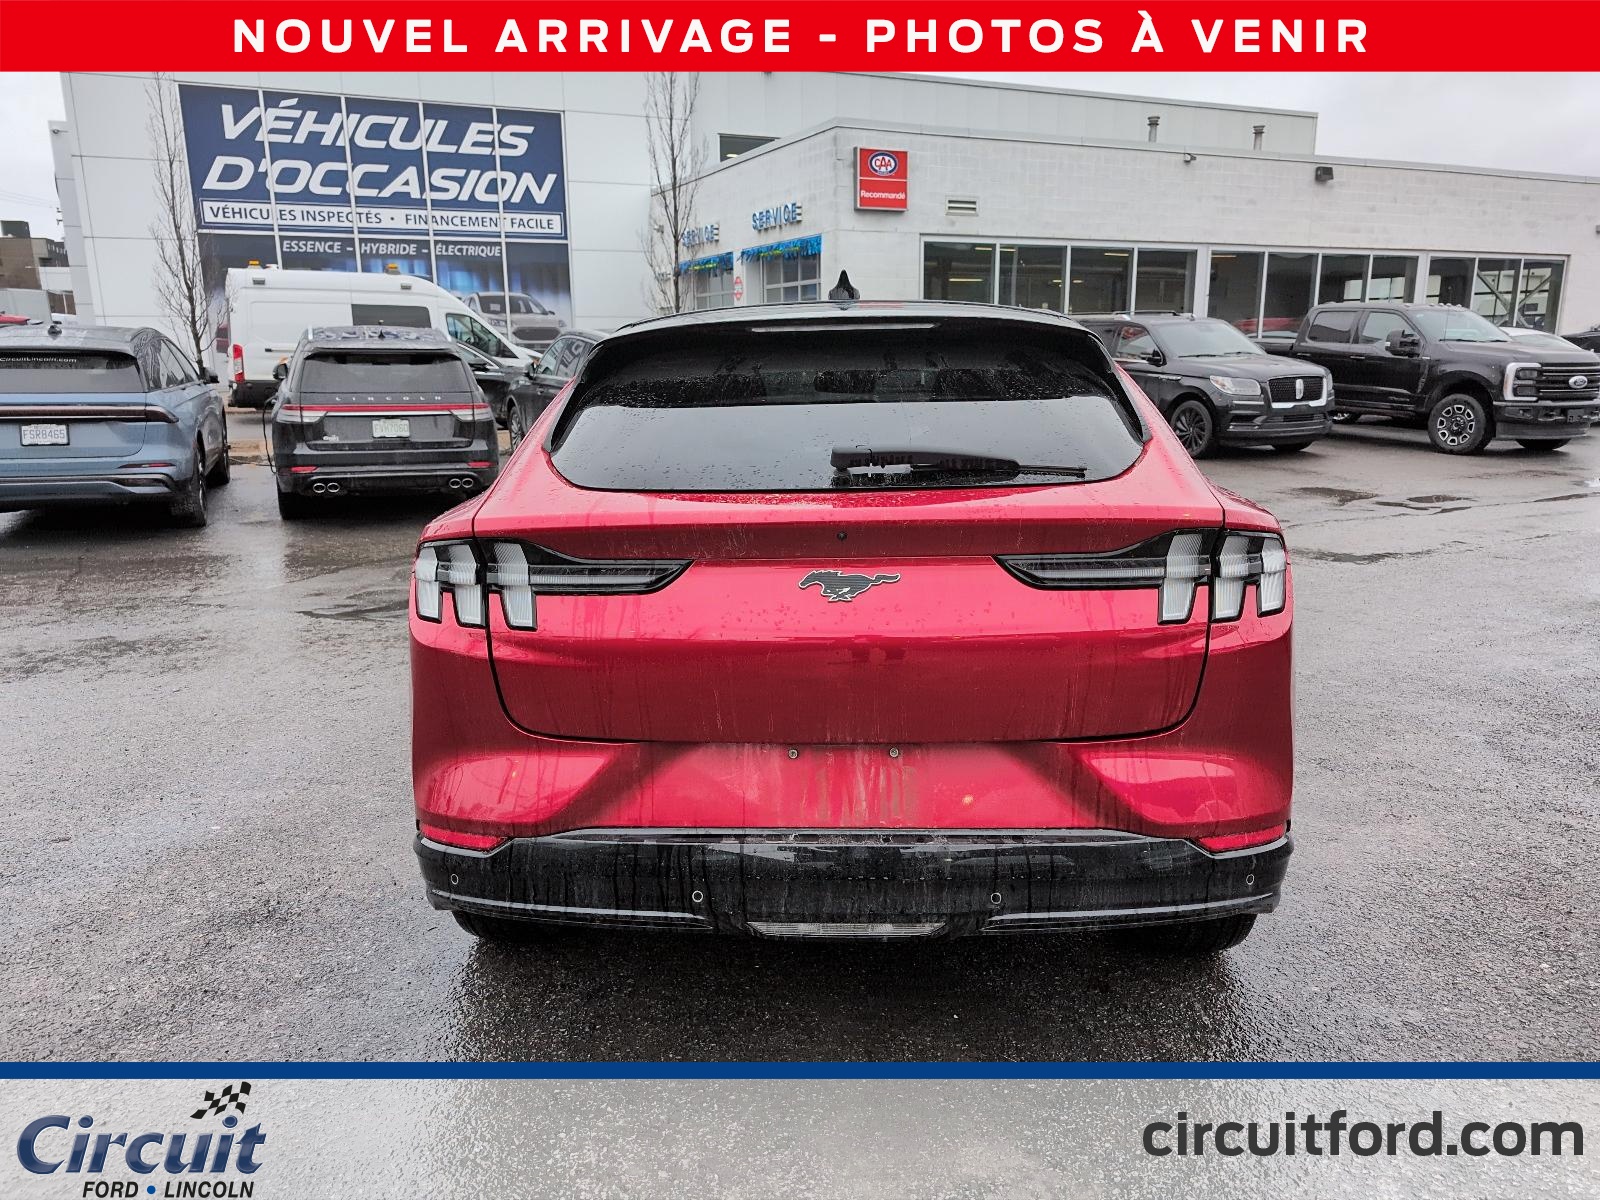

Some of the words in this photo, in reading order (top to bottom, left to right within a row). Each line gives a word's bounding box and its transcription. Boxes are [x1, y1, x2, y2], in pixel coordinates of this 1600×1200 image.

[221, 97, 535, 157] VÉHICULES
[875, 156, 892, 170] CAA
[202, 155, 558, 205] D'OCCASION
[860, 190, 906, 200] Recommandé
[209, 204, 297, 221] VÉHICUES
[301, 209, 383, 224] INSPECTÉS
[511, 218, 554, 230] FACILE
[752, 202, 802, 232] SERVICE
[282, 240, 342, 253] ESSENCE
[360, 242, 417, 256] HYBRIDE
[435, 243, 502, 257] ÉLECTRIQUE
[22, 429, 66, 439] FSR8465
